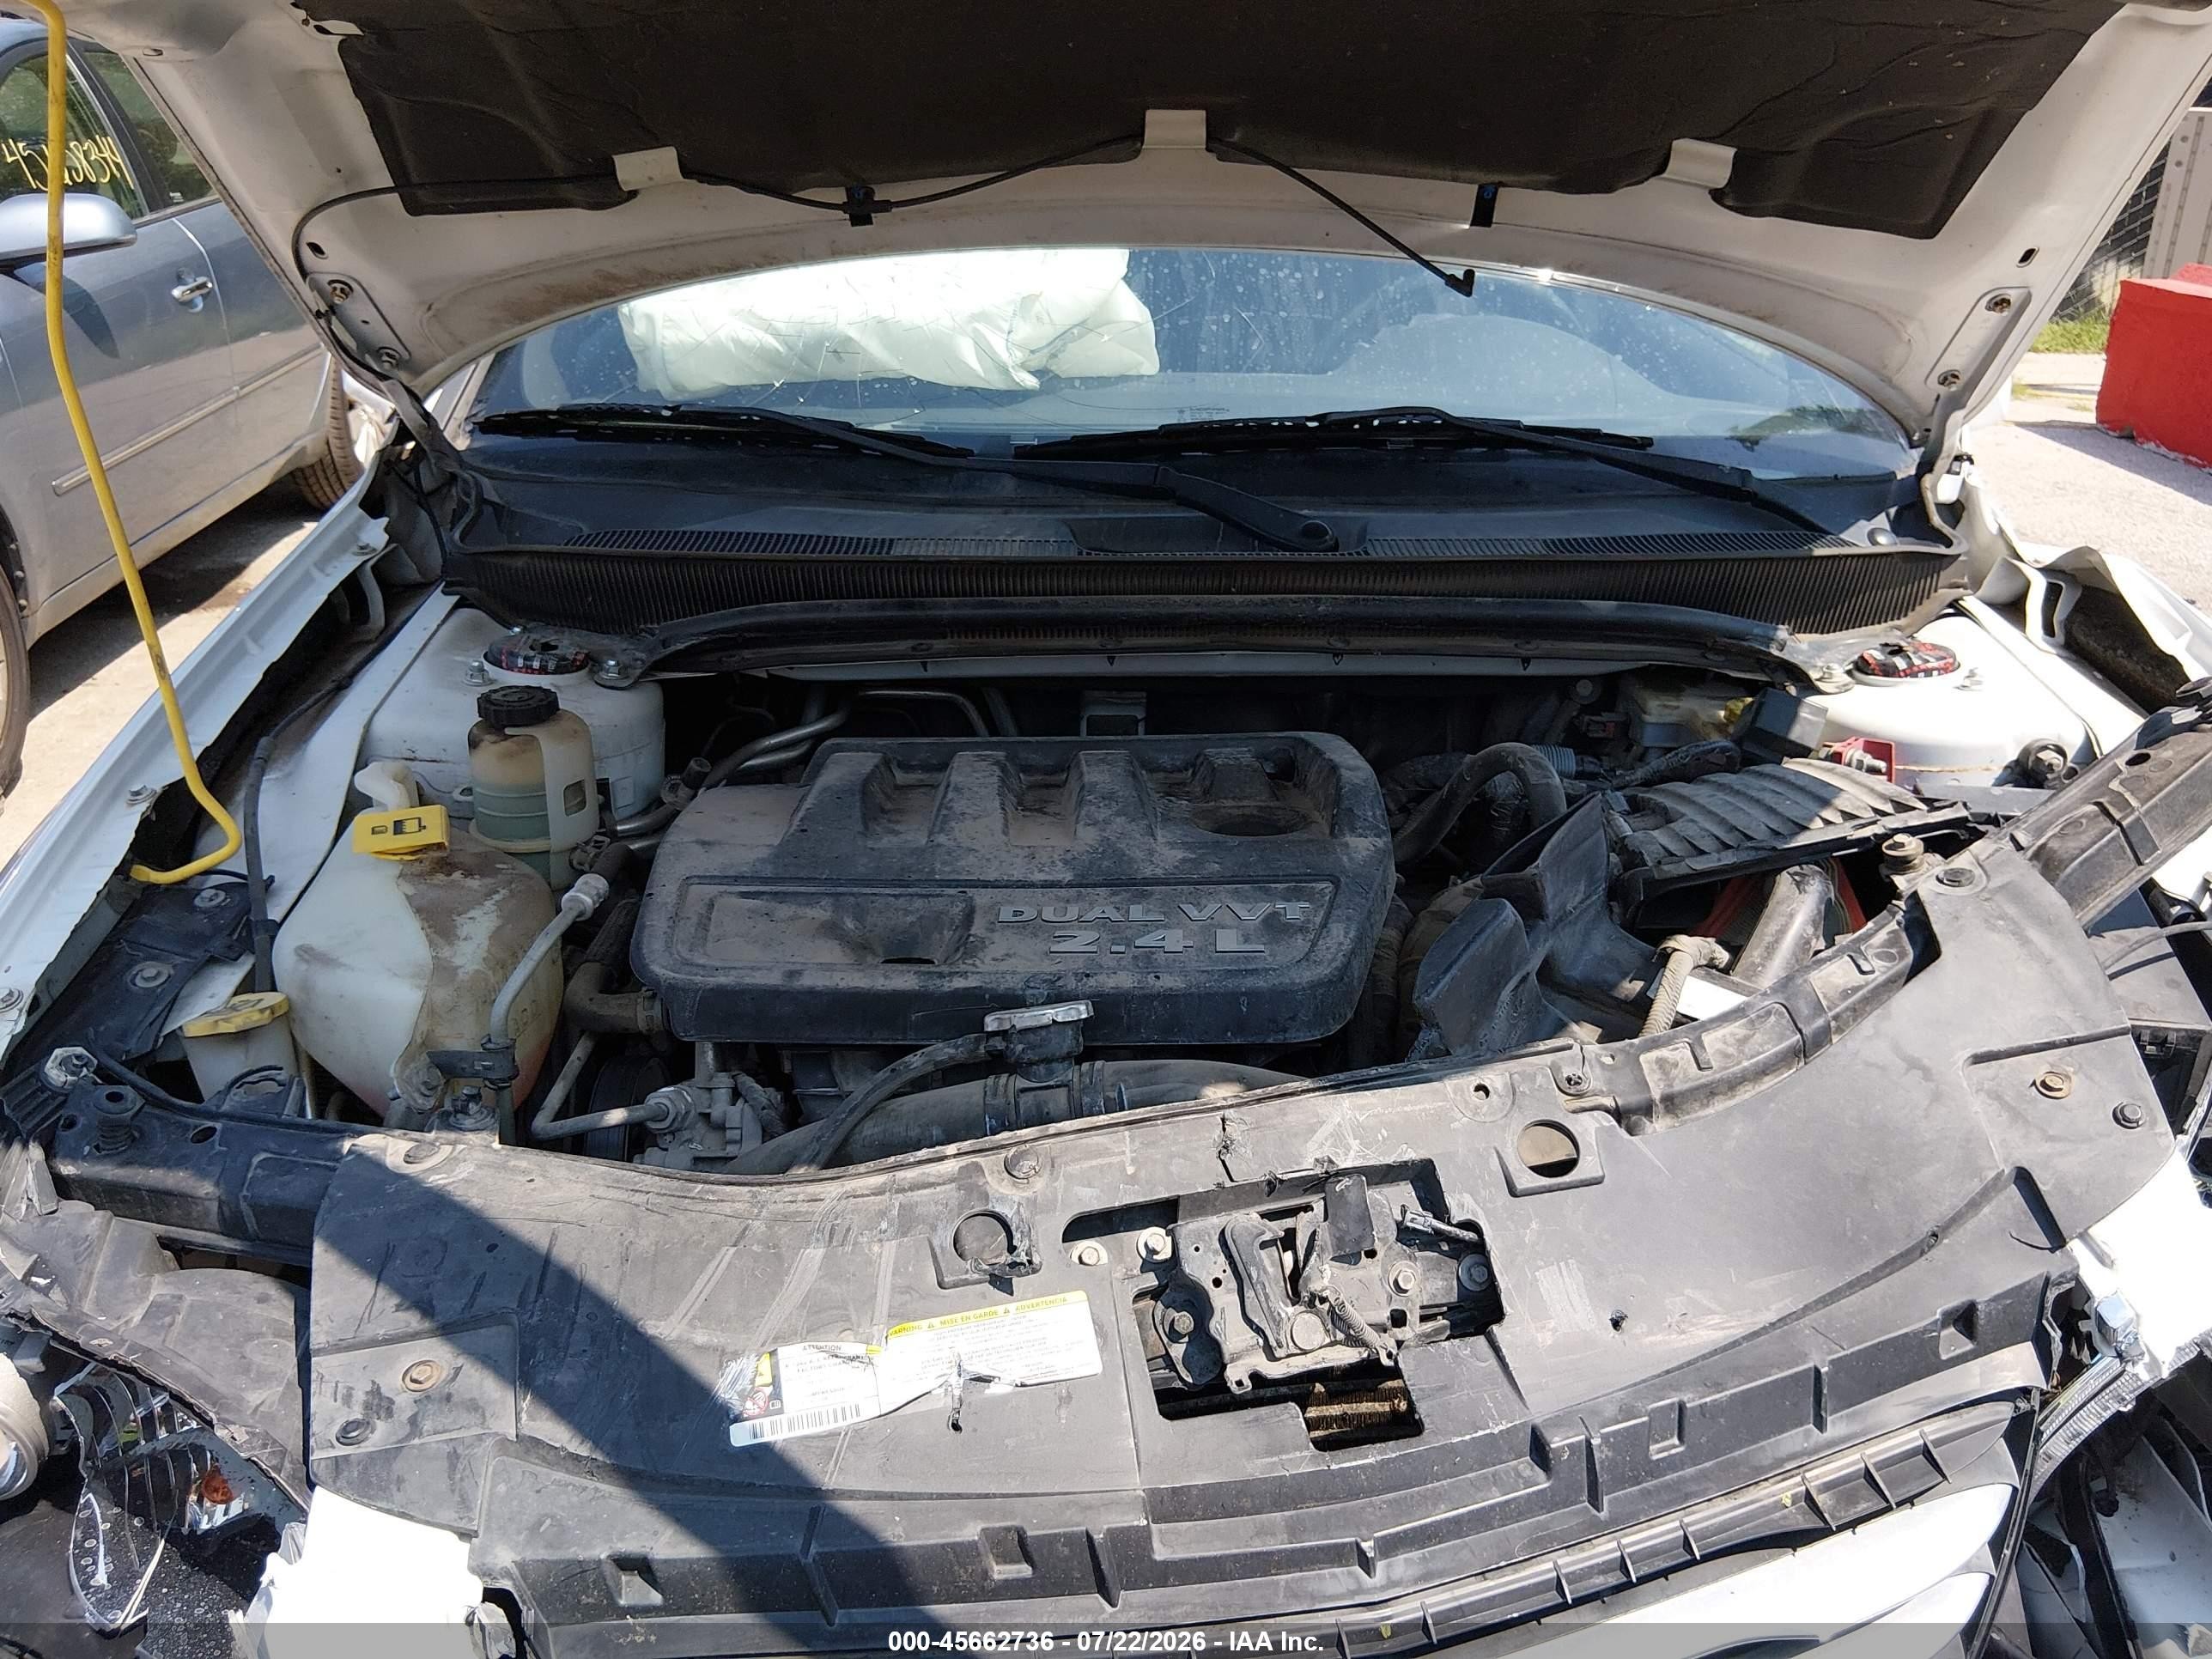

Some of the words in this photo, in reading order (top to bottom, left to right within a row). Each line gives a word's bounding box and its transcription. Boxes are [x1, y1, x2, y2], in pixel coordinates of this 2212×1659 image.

[997, 906, 1164, 923] DUAL
[1177, 902, 1310, 921] VVT
[939, 1315, 959, 1327] MISE
[961, 1313, 971, 1322] EN
[972, 1309, 1000, 1321] GARDE
[1015, 1295, 1068, 1311] ADVERTENCIA
